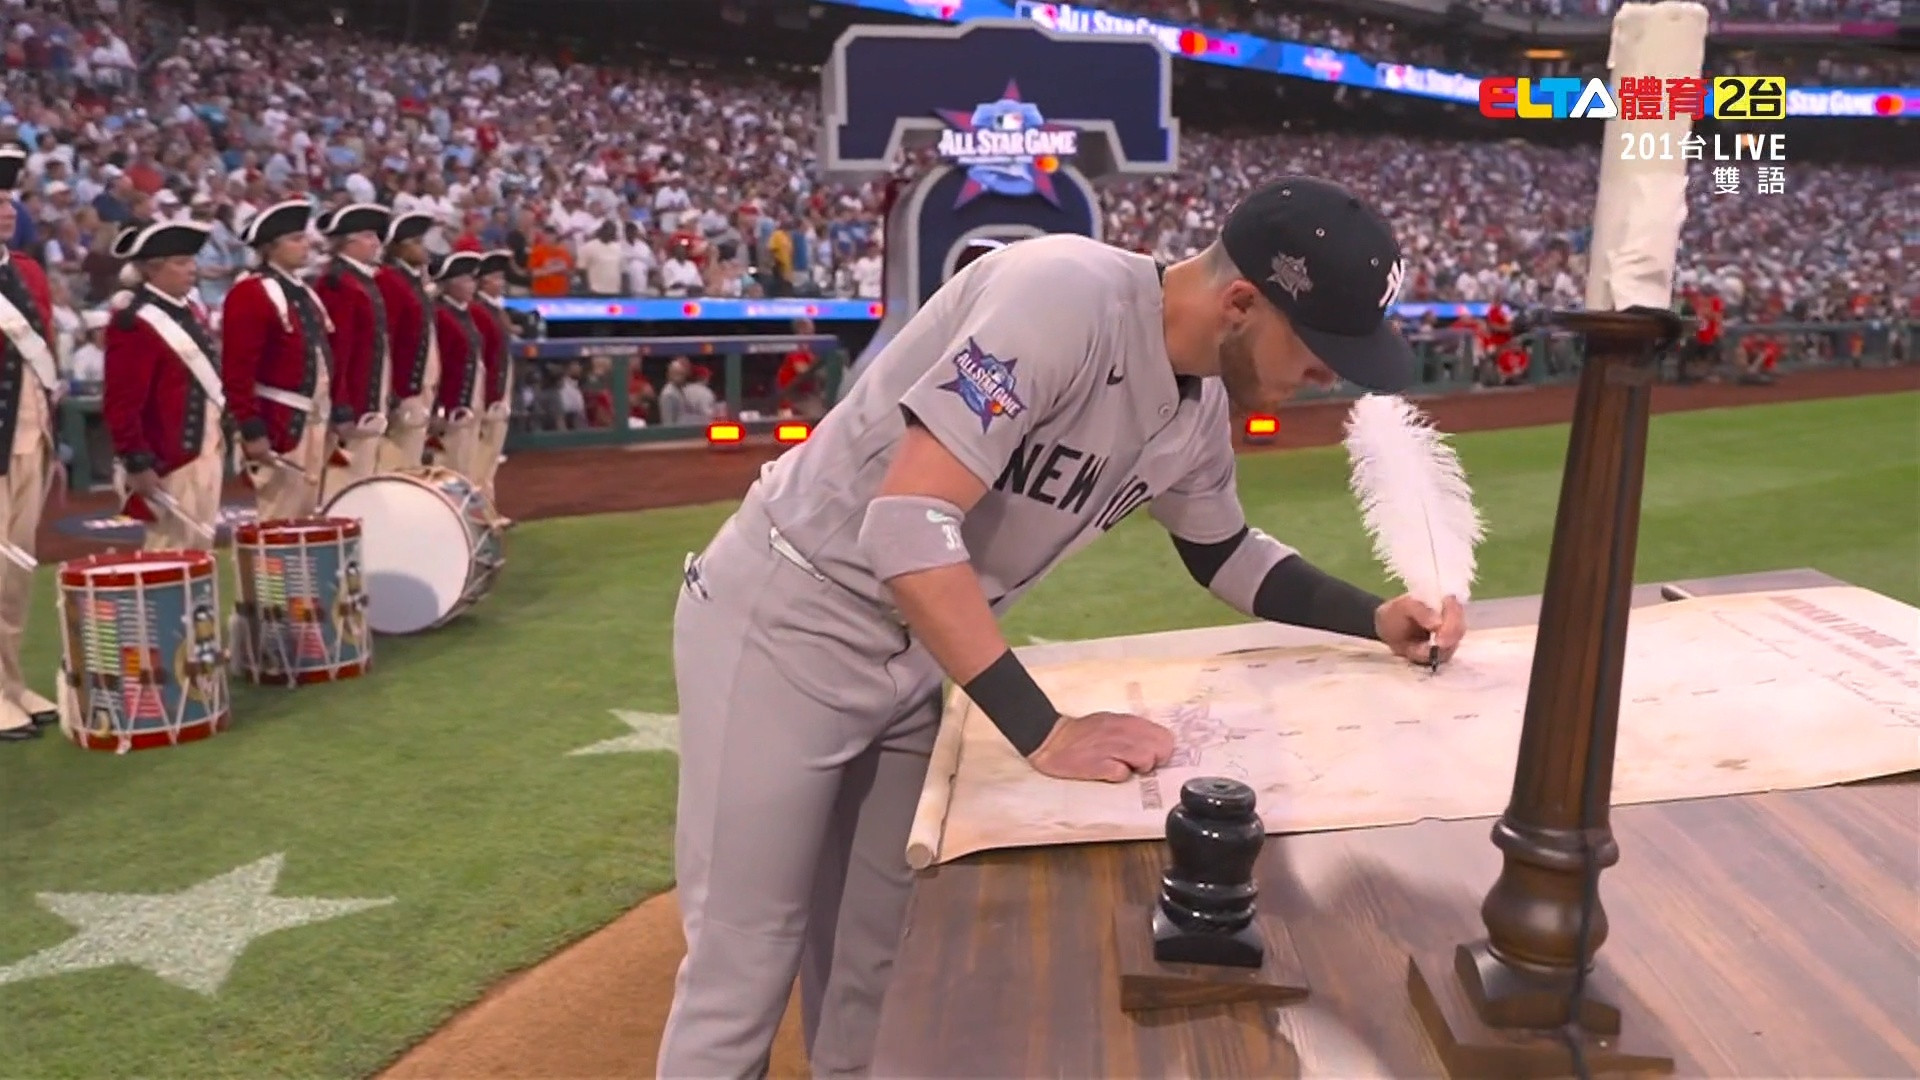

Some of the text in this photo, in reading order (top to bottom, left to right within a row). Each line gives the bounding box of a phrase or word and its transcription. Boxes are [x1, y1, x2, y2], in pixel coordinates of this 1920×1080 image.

[938, 128, 1078, 156] ALL STAR GAME
[957, 352, 1021, 417] ALL STAR GAME
[993, 434, 1108, 515] NEW
